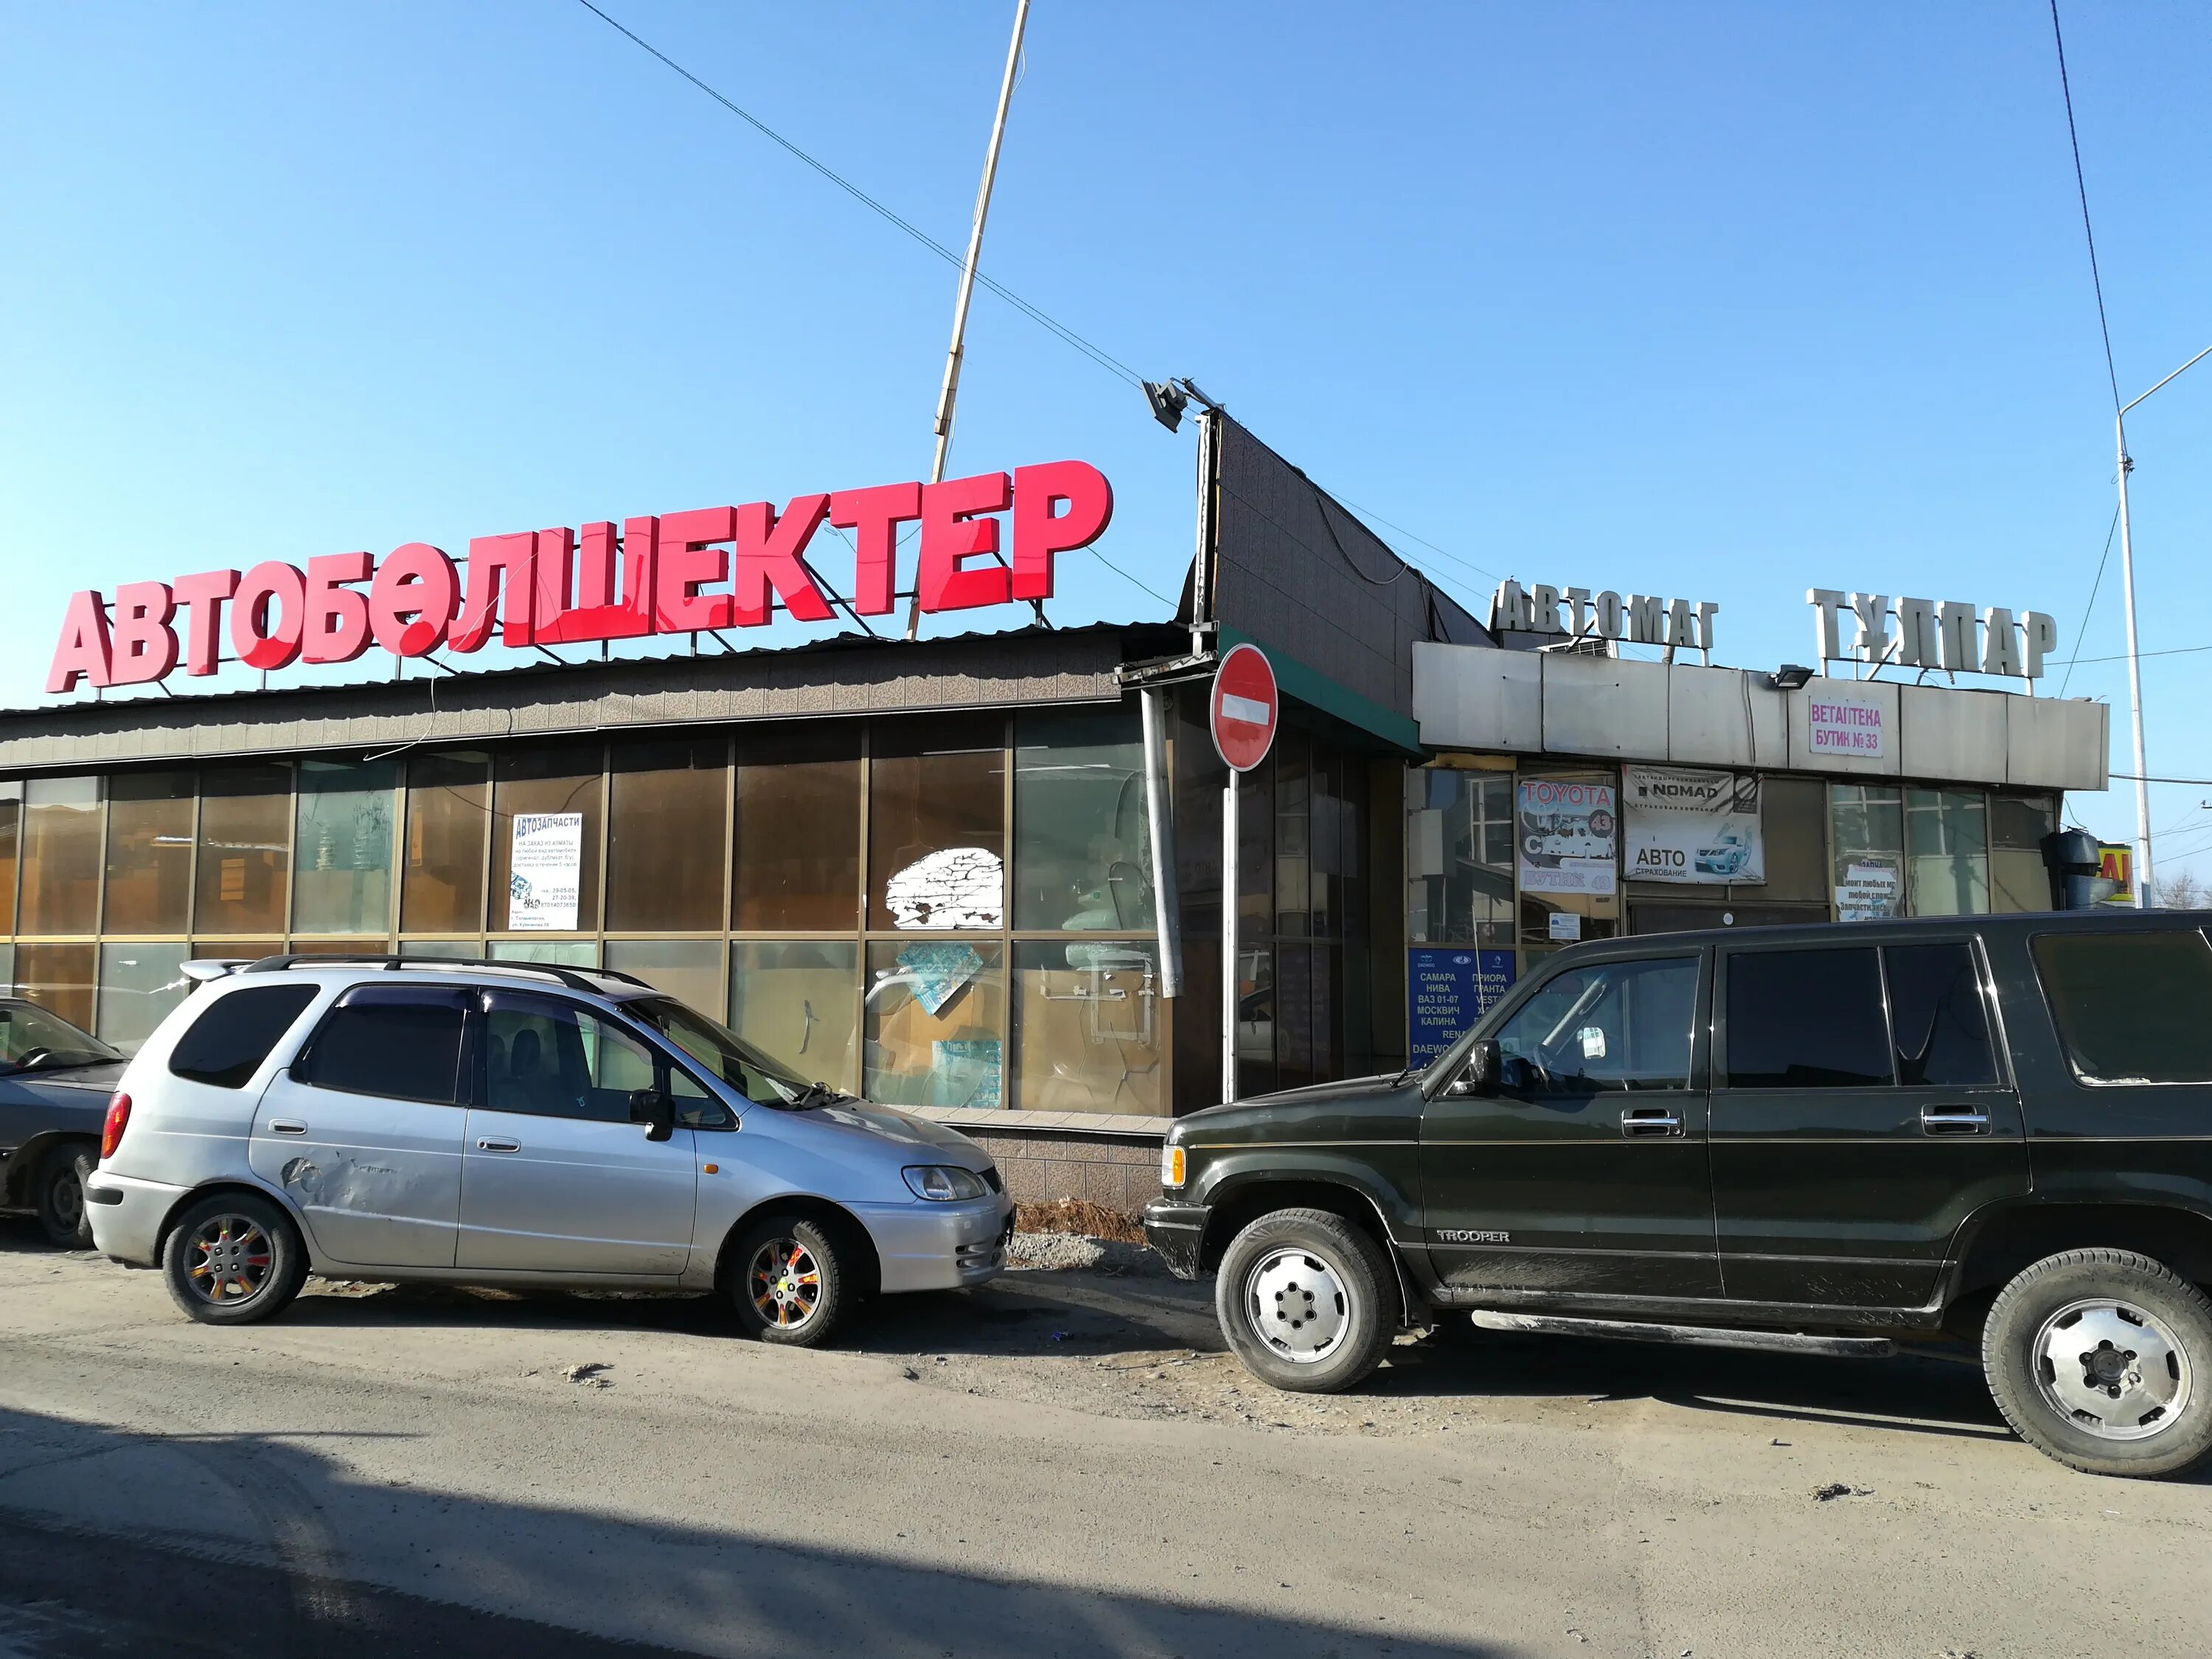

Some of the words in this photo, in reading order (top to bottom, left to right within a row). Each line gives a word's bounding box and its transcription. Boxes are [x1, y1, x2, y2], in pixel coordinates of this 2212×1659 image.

[45, 460, 1113, 693] АВТОБӨЛШЕКТЕР
[1498, 580, 1719, 649] АВТОМАГ
[1812, 704, 1882, 727] ВЕТАПТЕКА
[1816, 729, 1850, 747] БУТИК
[1852, 732, 1864, 748] №
[1865, 734, 1878, 749] 33
[1522, 782, 1612, 807] TOYOTA
[1653, 784, 1719, 798] NOMAD
[516, 818, 580, 839] АВТОЗАПЧАСТИ
[1591, 814, 1611, 831] 43
[1636, 848, 1686, 867] АВТО
[1635, 867, 1687, 877] СТРАХОВАНИЕ
[1420, 973, 1456, 981] САМАРА
[1472, 974, 1507, 983] ПРИОРА
[1426, 984, 1450, 992] НИВА
[1474, 985, 1506, 993] ГРАНТА
[1418, 995, 1435, 1004] ВАЗ
[1437, 995, 1459, 1004] 01-07
[1476, 995, 1502, 1004] VEST
[1417, 1006, 1460, 1015] МОСКВИЧ
[1421, 1018, 1457, 1026] КАЛИНА
[1436, 1229, 1510, 1242] TROOPER
